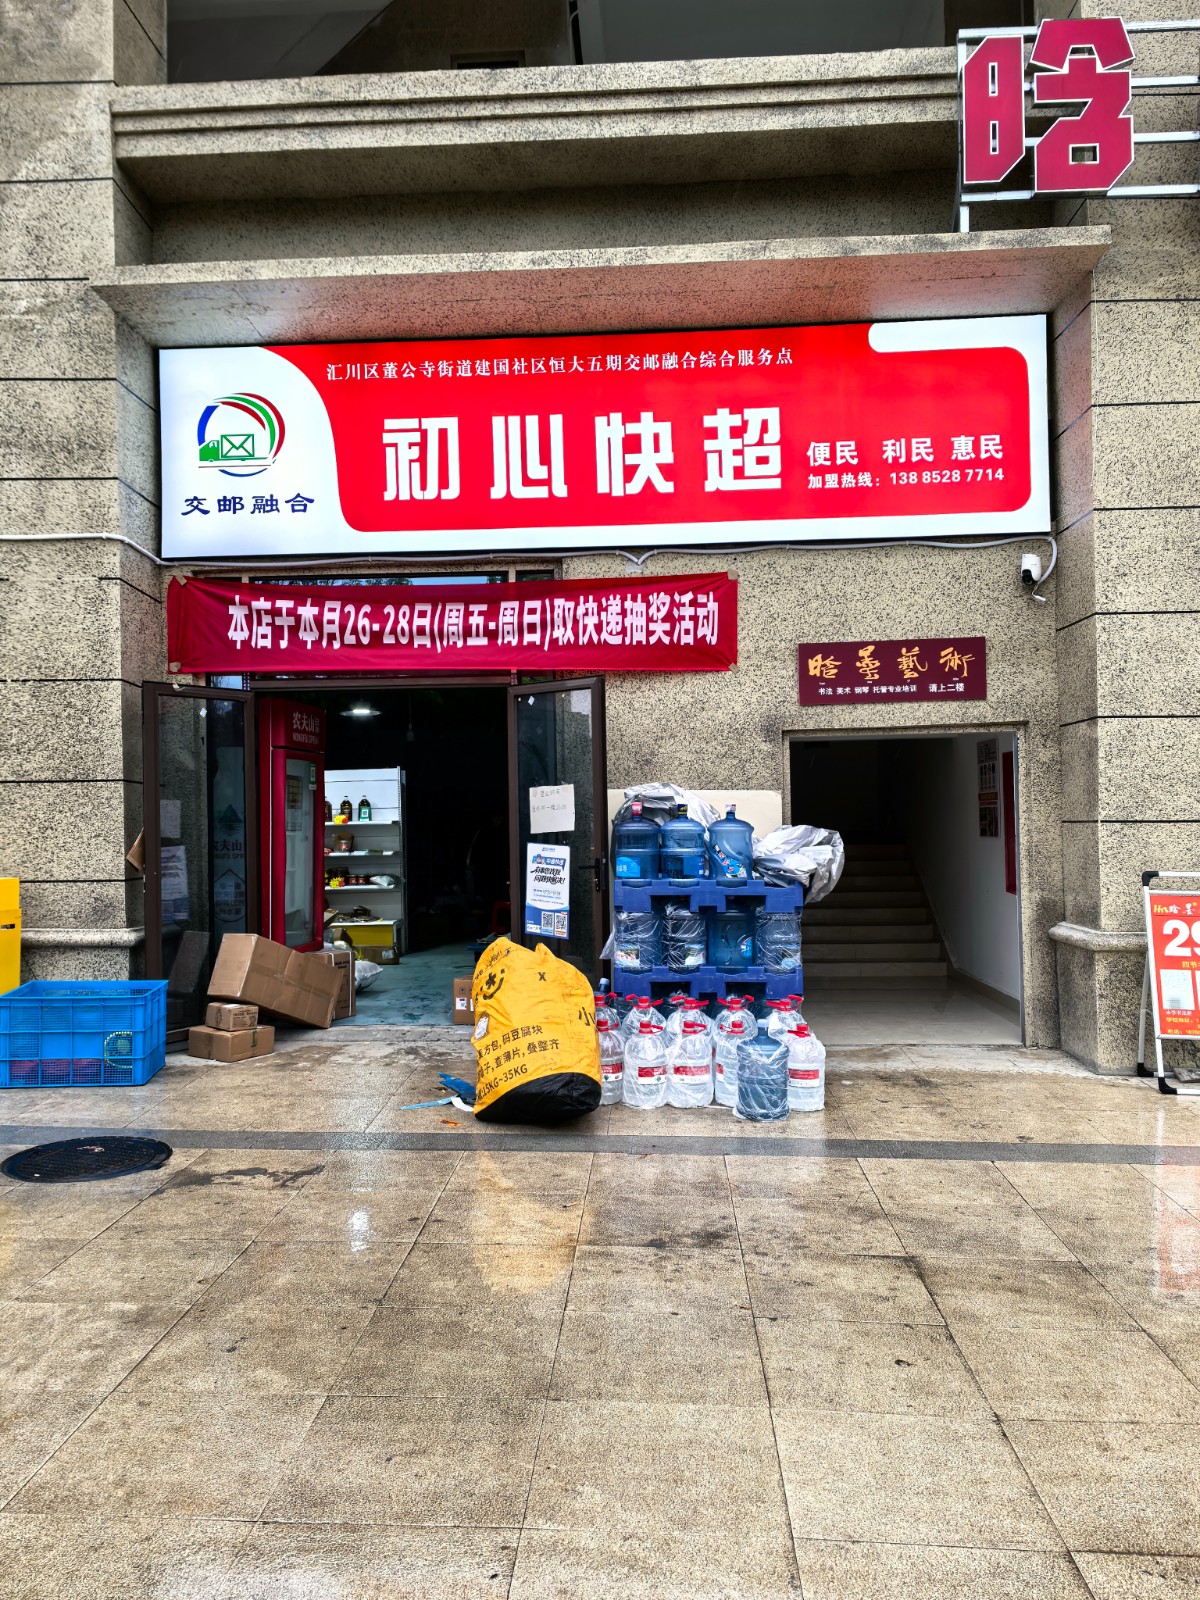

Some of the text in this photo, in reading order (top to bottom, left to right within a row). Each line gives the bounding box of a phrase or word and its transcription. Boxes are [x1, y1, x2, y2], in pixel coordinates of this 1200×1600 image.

[326, 347, 793, 381] 汇川区董公寺街道建国社区恒大五期交邮融合综合服务点
[382, 407, 782, 501] 初心快超
[806, 434, 1003, 467] 便民 利民 惠民
[890, 471, 918, 485] 138
[922, 470, 961, 484] 8528
[965, 468, 1004, 482] 7714
[181, 493, 315, 516] 交邮融合
[227, 591, 718, 652] 本店于本月26-28日(周五-周日)取快递抽奖活动
[818, 682, 965, 696] 书法 美术 钢琴 托管专业培训 请上二楼
